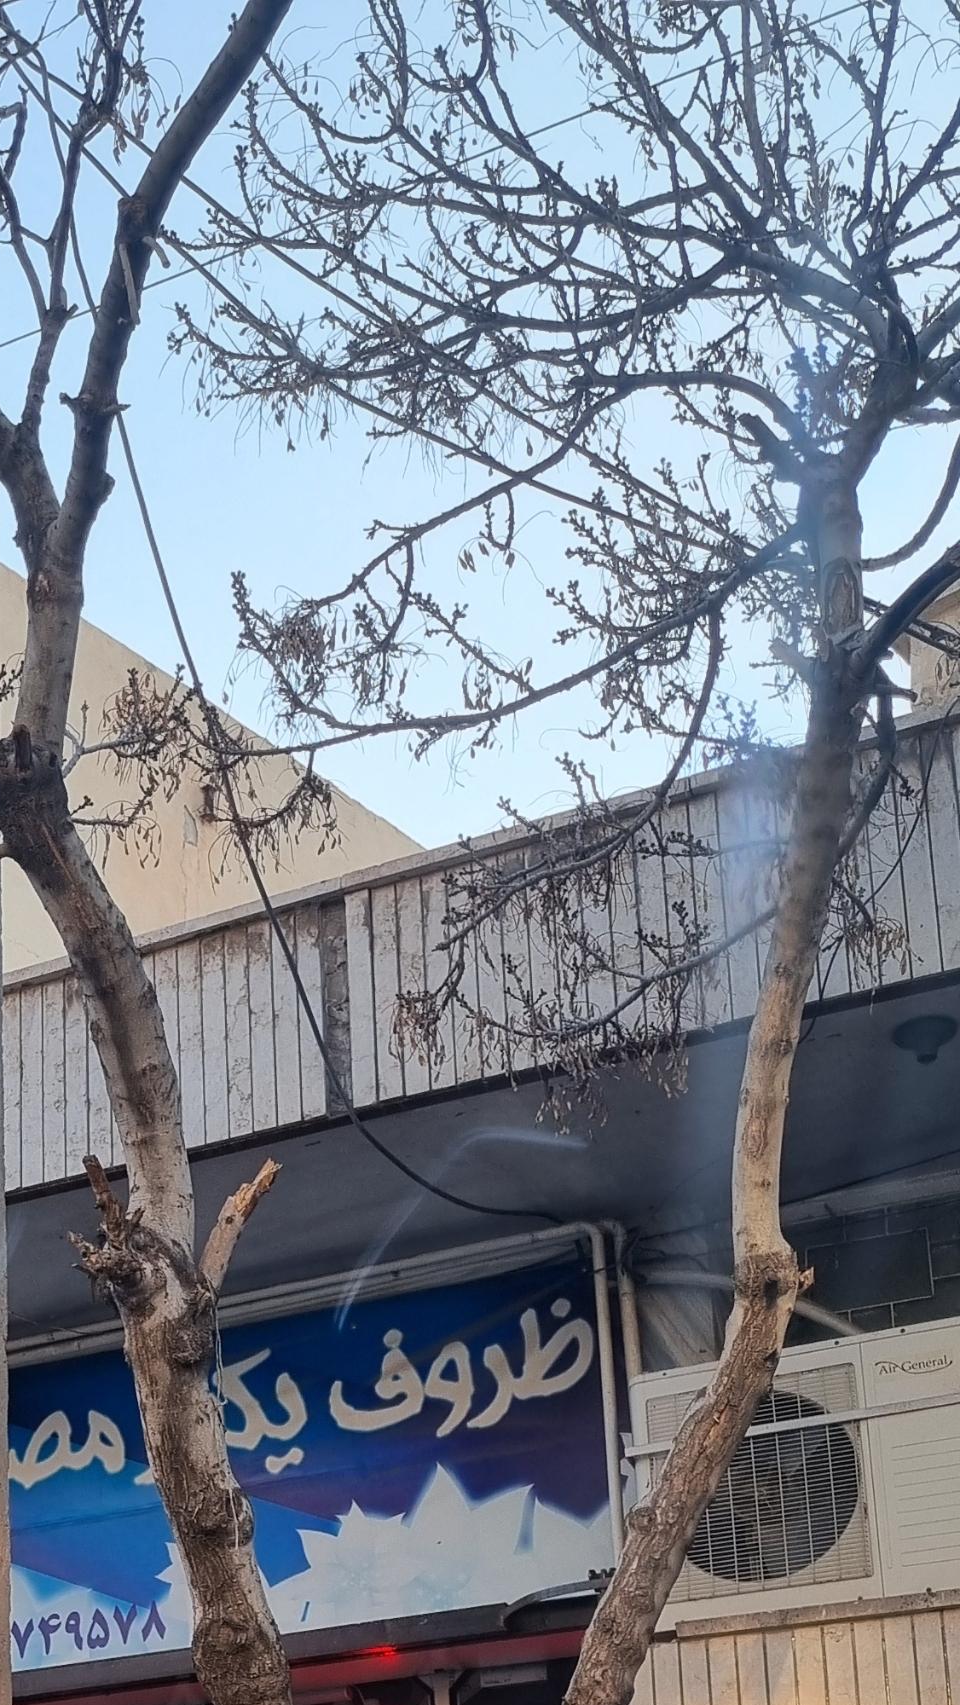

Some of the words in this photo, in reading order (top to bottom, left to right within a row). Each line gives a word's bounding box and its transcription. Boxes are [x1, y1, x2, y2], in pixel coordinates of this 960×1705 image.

[329, 1298, 594, 1438] ظروف
[878, 1362, 897, 1376] Air
[901, 1354, 948, 1371] General
